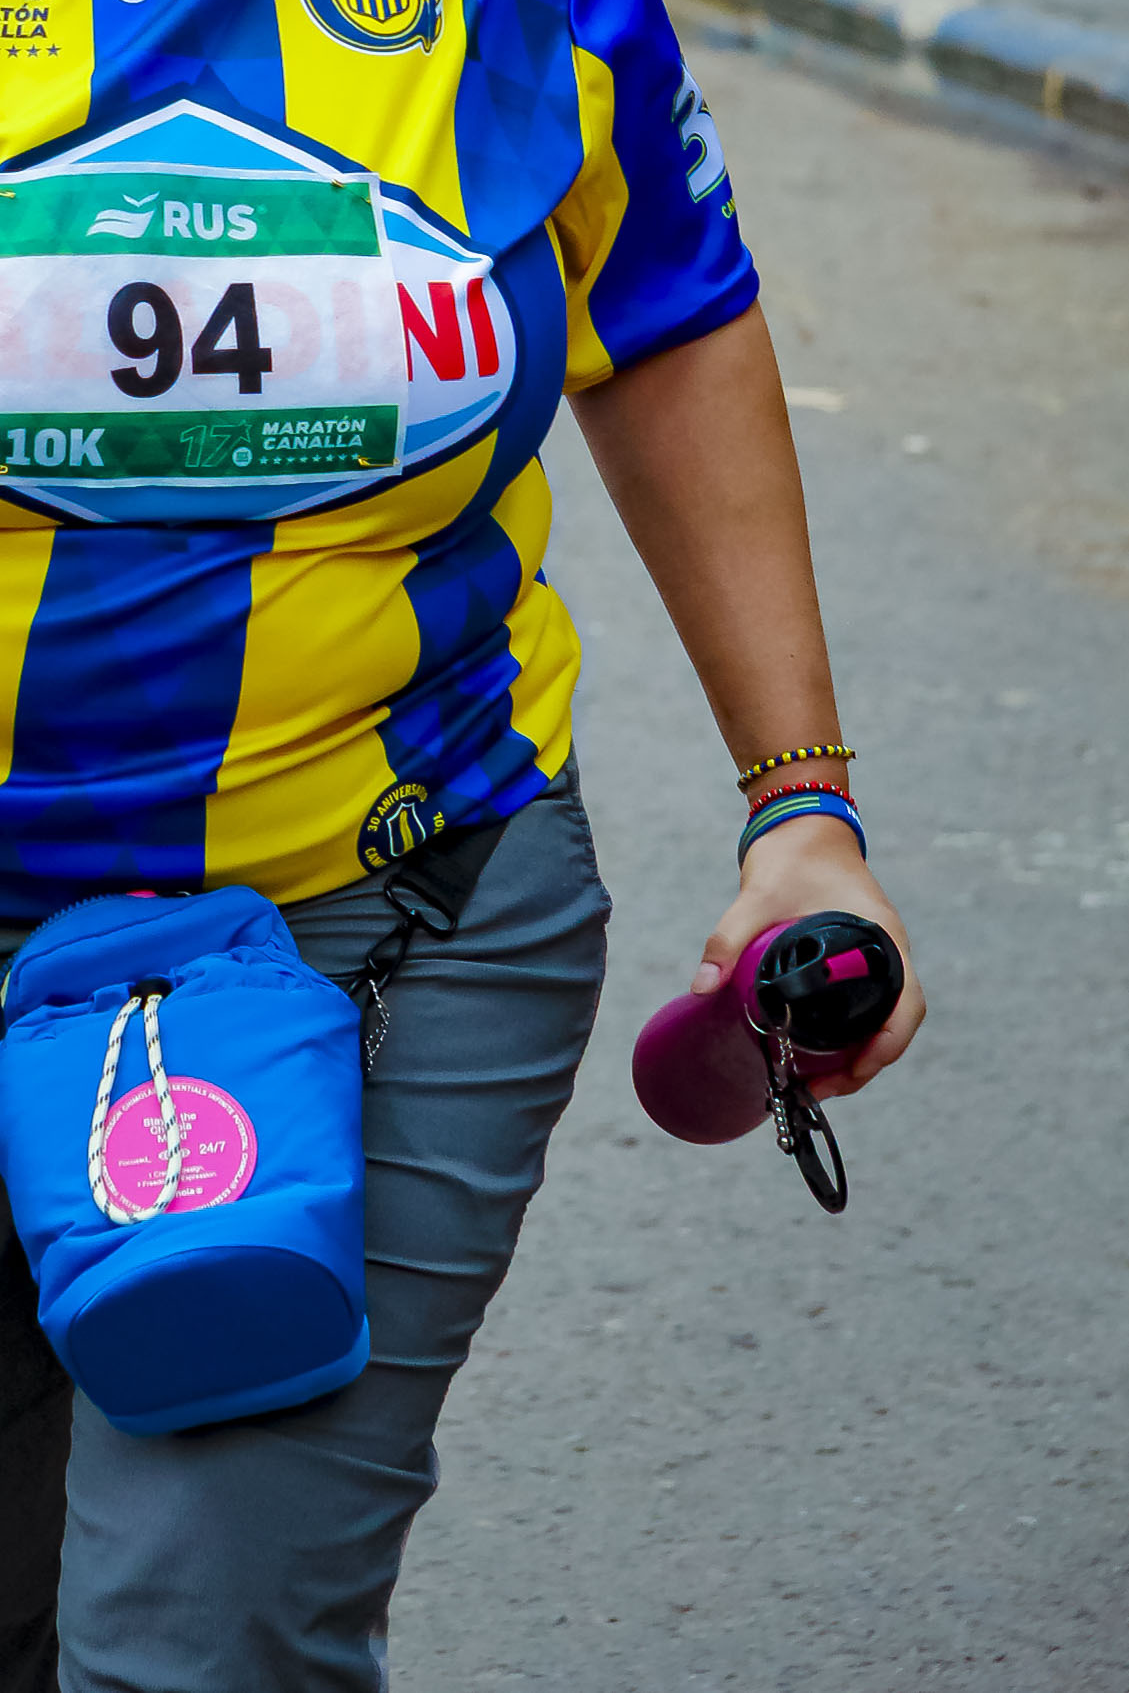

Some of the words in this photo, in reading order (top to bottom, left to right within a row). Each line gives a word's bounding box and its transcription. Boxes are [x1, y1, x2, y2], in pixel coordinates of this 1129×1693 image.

[162, 200, 258, 242] RUS
[107, 281, 272, 399] 94
[262, 415, 366, 435] MARATÓN
[4, 427, 105, 468] 10K
[263, 434, 363, 450] CANALLA
[199, 1140, 226, 1155] 24/7
